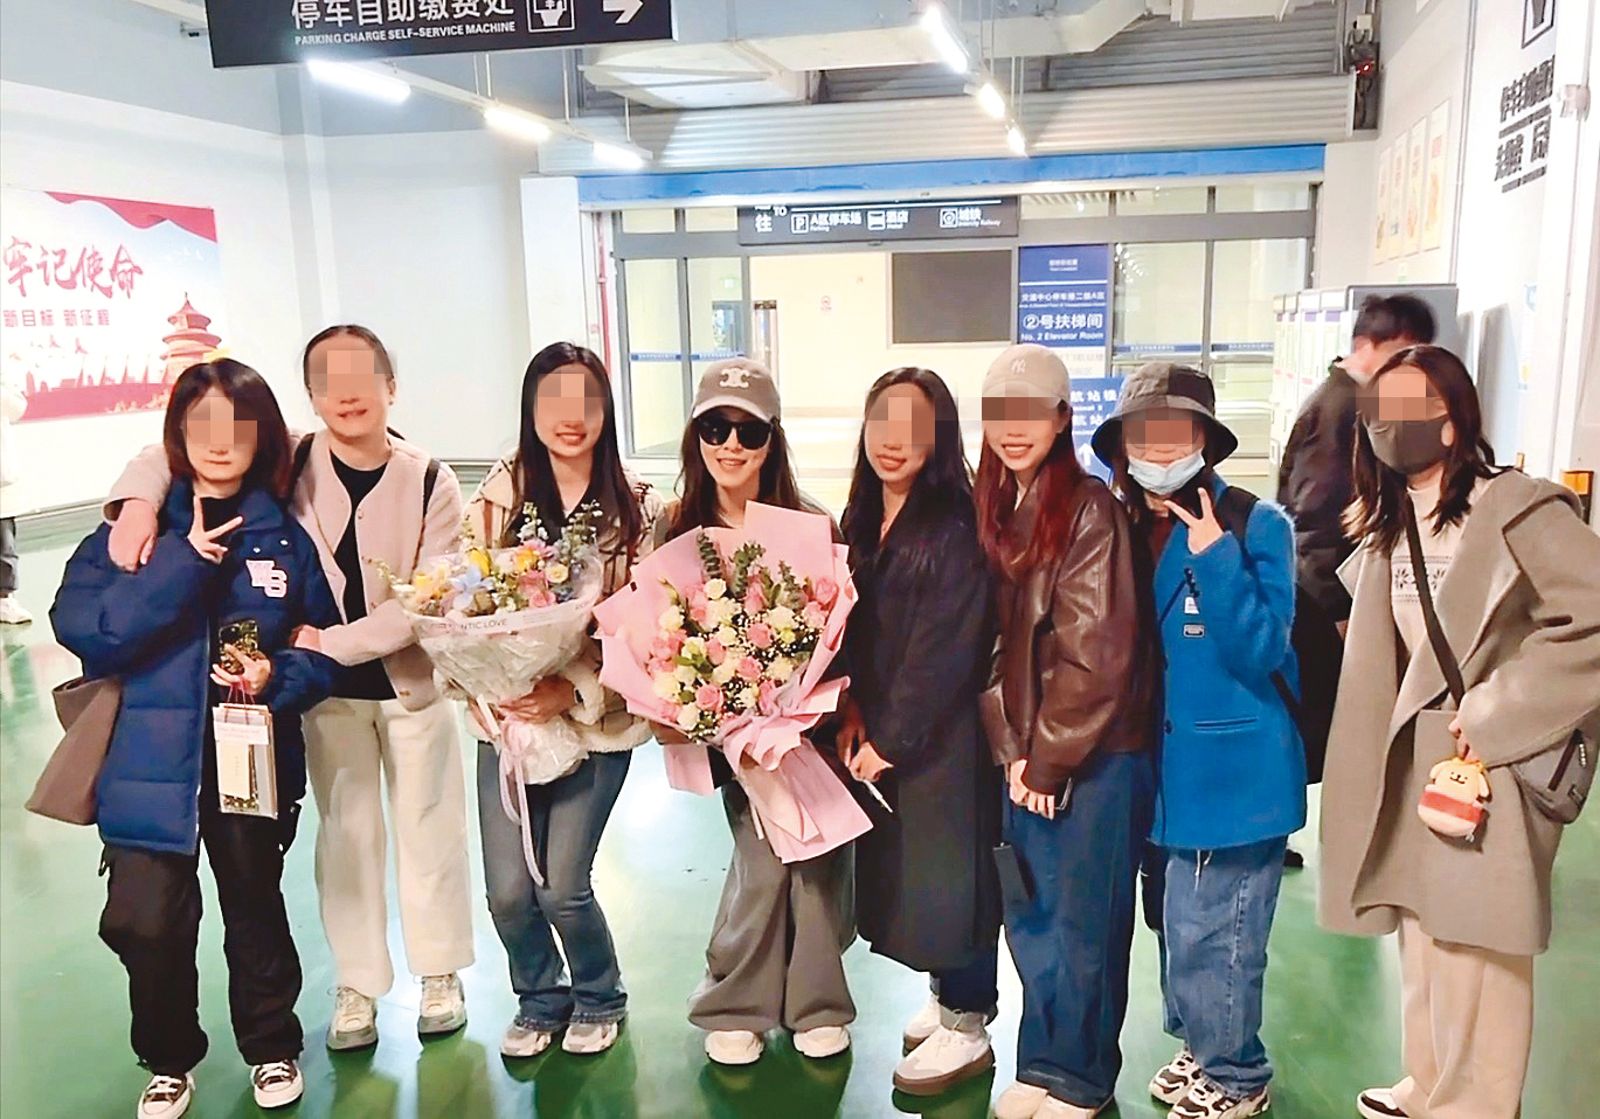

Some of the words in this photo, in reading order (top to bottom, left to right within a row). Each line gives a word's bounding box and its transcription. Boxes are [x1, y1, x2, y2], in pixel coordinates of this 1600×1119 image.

[292, 0, 515, 29] 停车自助缴费处
[295, 33, 341, 45] PARKING
[343, 29, 386, 42] CHARGE
[388, 25, 464, 40] SELF-SERVICE
[465, 21, 516, 34] MACHINE
[773, 206, 787, 217] TO
[3, 236, 143, 299] 牢记使命
[1044, 331, 1078, 340] Elevator
[1079, 331, 1104, 340] Room
